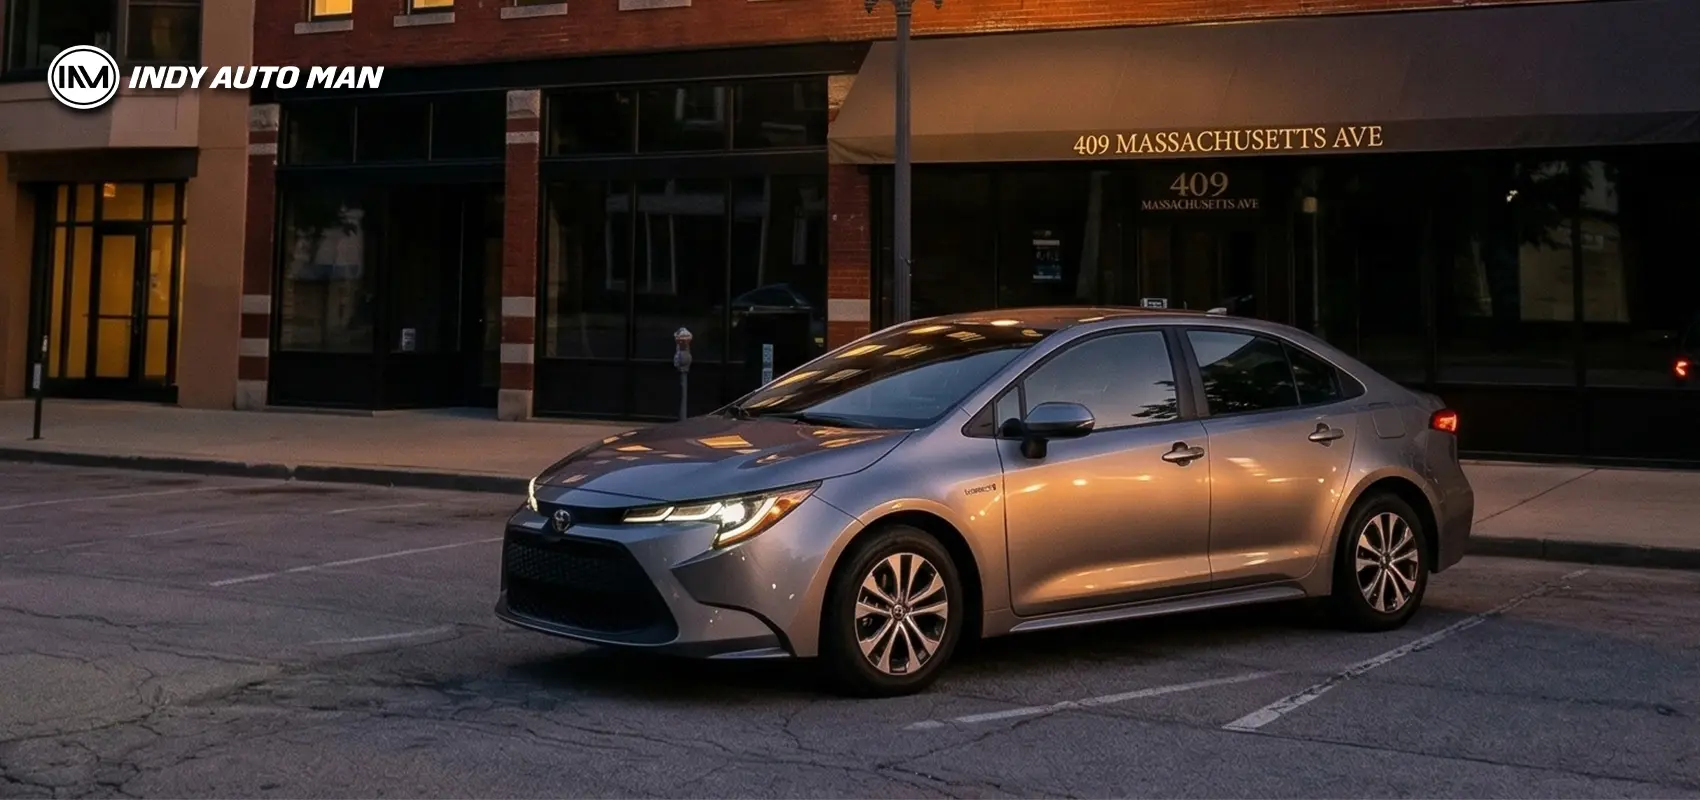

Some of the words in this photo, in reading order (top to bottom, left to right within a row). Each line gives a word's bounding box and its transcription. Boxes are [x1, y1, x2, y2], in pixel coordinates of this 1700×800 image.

[1073, 134, 1110, 155] 409
[1115, 127, 1327, 154] MASSACHUSETTS
[1333, 125, 1384, 148] AVE
[1169, 171, 1229, 197] 409
[1140, 198, 1235, 211] MASSACHUSETTS
[1236, 198, 1259, 210] AVE
